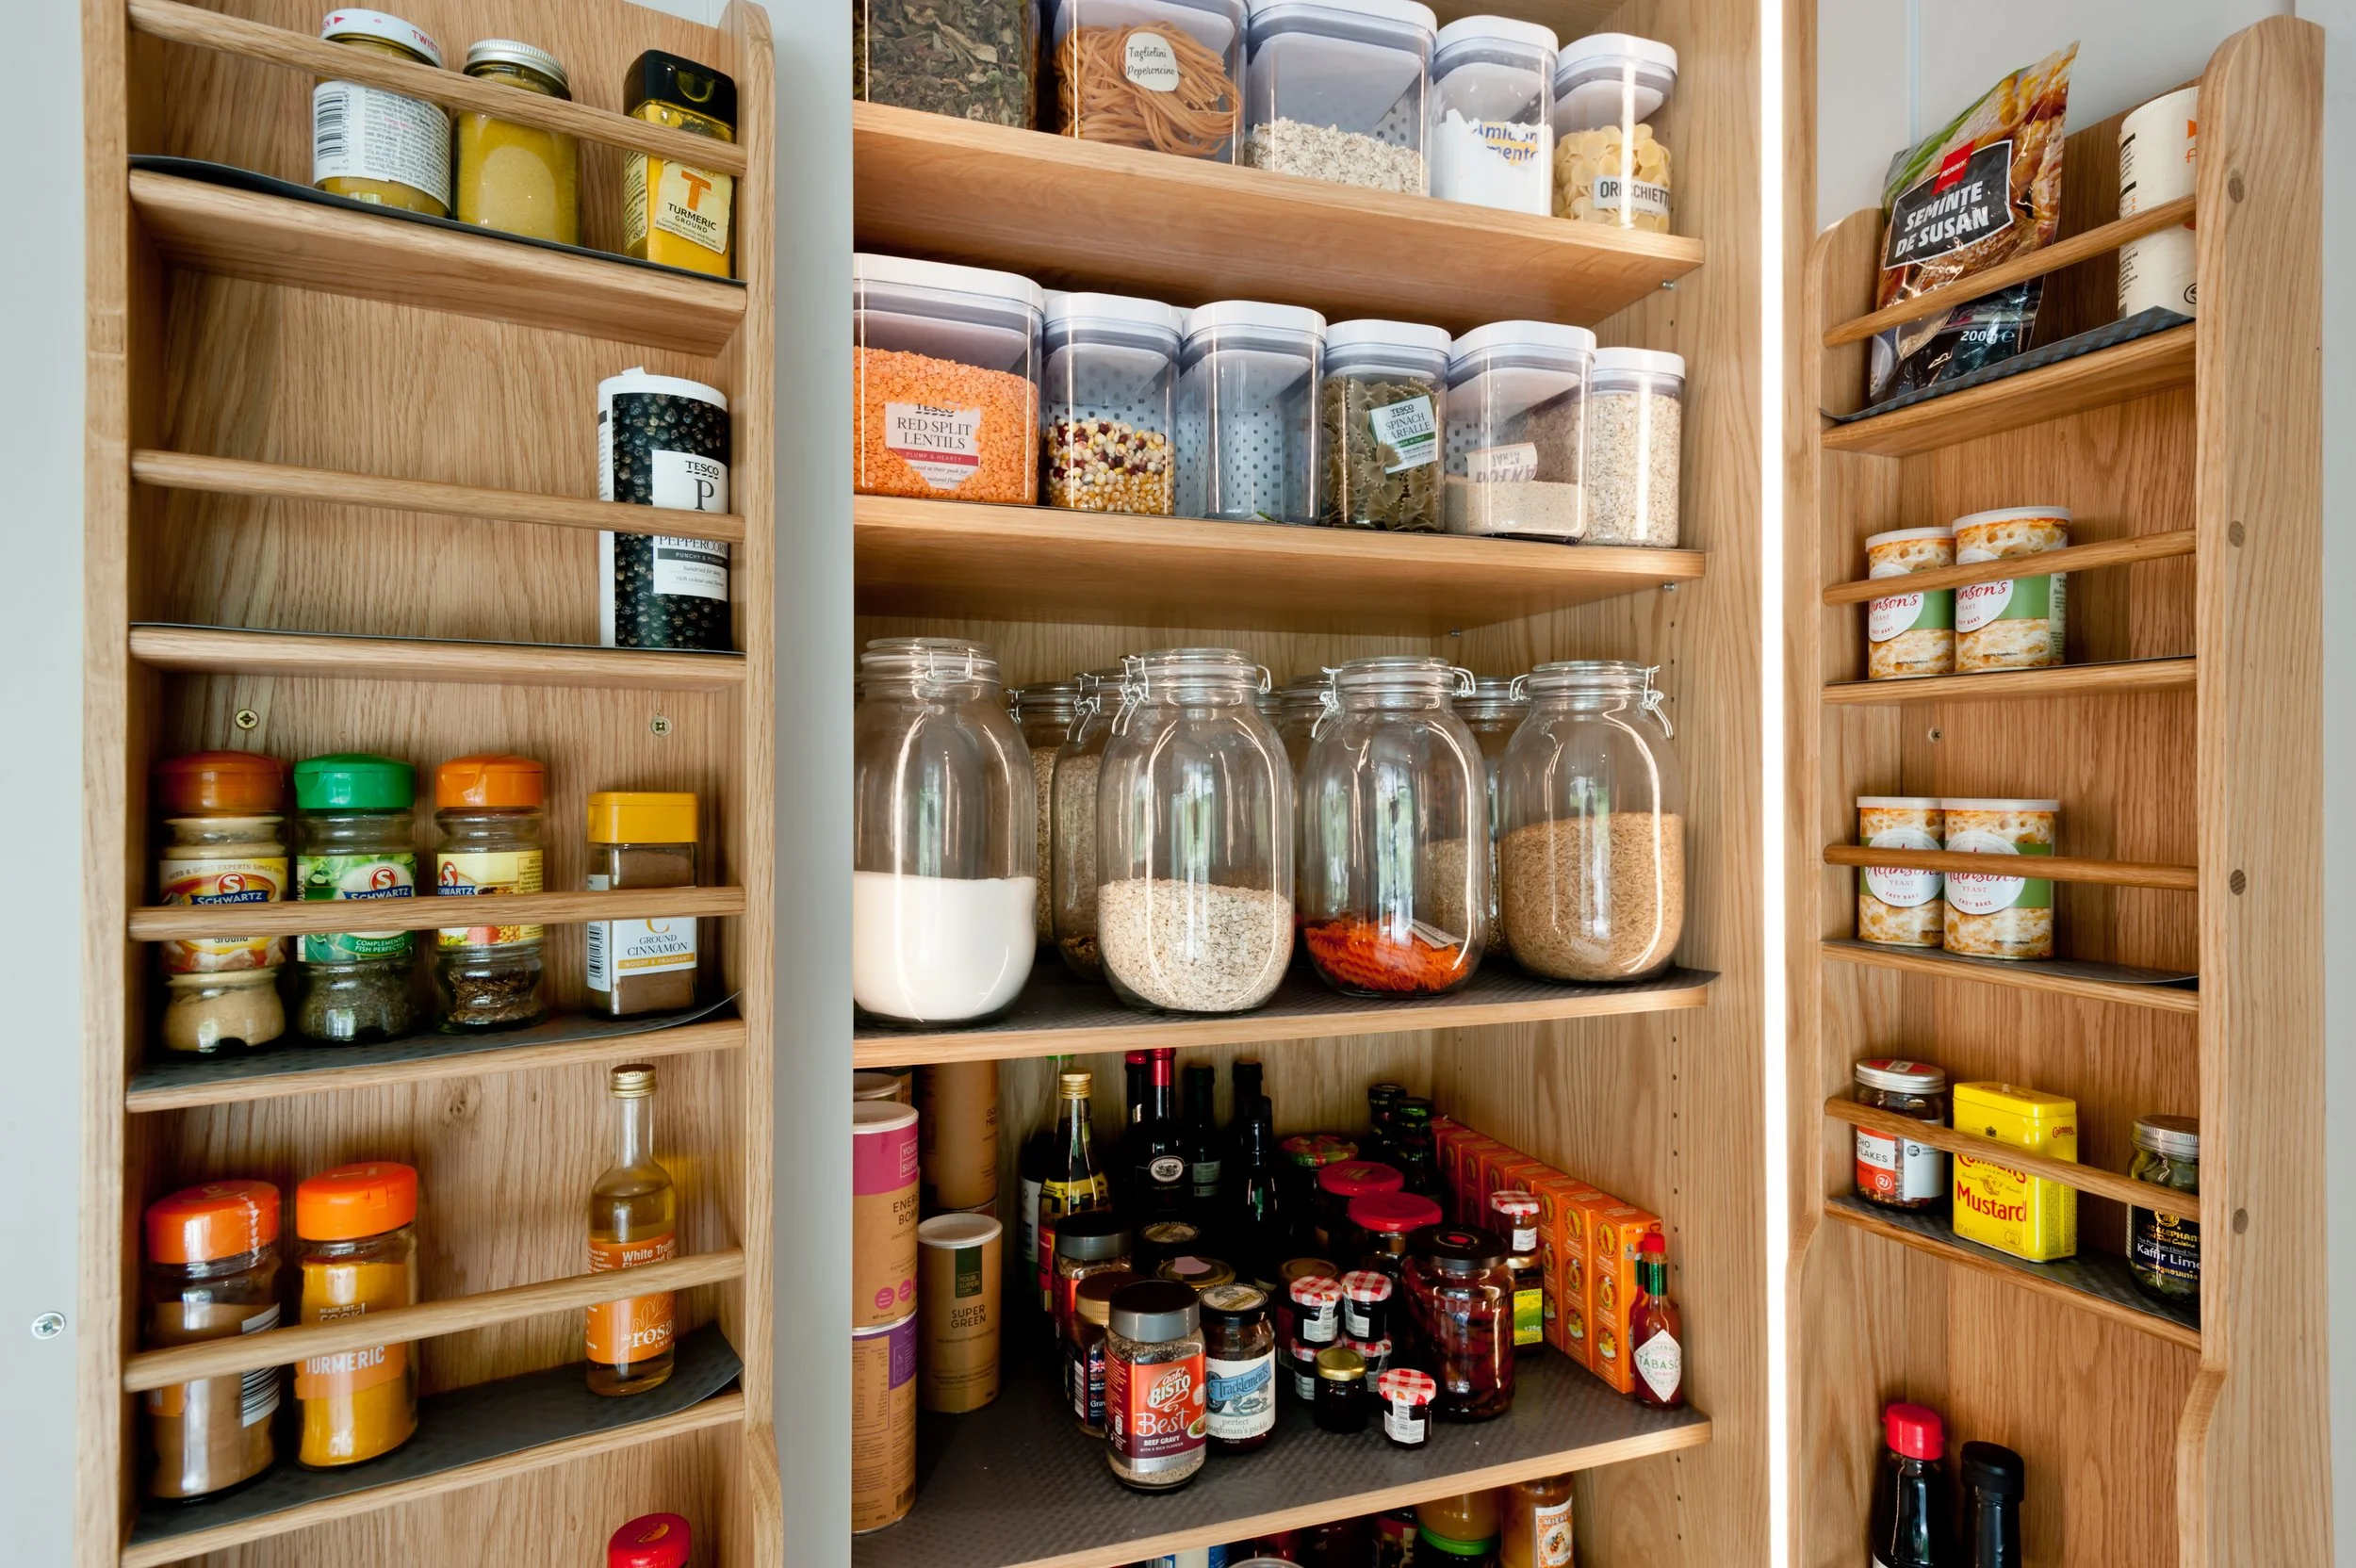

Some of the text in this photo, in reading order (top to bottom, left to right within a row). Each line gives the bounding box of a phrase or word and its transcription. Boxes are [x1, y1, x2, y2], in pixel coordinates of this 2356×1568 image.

[411, 29, 438, 53] TWIST
[1128, 46, 1168, 62] Tagliolini
[1127, 64, 1175, 80] Peperoncino
[680, 170, 712, 212] T
[1600, 181, 1672, 209] ORCHIETT
[667, 202, 717, 231] TURMERIC
[675, 215, 708, 234] GROUND
[1894, 233, 1918, 259] DE
[1390, 404, 1415, 415] TESCO
[897, 416, 972, 436] RED SPLIT
[1385, 412, 1426, 431] SPINACH
[1384, 421, 1432, 440] ARFALLE
[904, 432, 965, 449] LENTILS
[684, 460, 719, 476] TESCO
[694, 478, 714, 511] P
[675, 551, 701, 561] PUNCHY
[253, 863, 271, 872] SINCE
[196, 891, 263, 905] SCHWARTZ
[351, 888, 409, 900] SCHWARTZ
[1885, 890, 1901, 900] EASY
[1958, 898, 1972, 906] EASY
[355, 936, 404, 947] COMPLEMENTS
[372, 941, 405, 953] PERFECTLY
[639, 934, 678, 945] GROUND
[627, 941, 688, 956] CINNAMON
[624, 959, 648, 968] WOODY
[658, 955, 693, 965] FRAGRANT
[2052, 1125, 2074, 1138] Colman's
[1956, 1180, 2027, 1222] Mustard
[898, 1206, 918, 1226] BOM
[2171, 1238, 2196, 1249] Cuisine
[622, 1248, 653, 1263] White
[2137, 1243, 2167, 1261] Kaffir
[2169, 1254, 2201, 1269] Lime
[951, 1304, 986, 1319] SUPER
[950, 1314, 987, 1329] GREEN
[631, 1319, 674, 1348] rosa
[306, 1345, 385, 1375] TURMERIC
[1638, 1353, 1680, 1370] TABASC
[1215, 1366, 1269, 1397] Tracklements
[1150, 1375, 1191, 1407] BISTO
[1136, 1407, 1191, 1437] Best
[1206, 1420, 1268, 1436] oughman's pickle
[1221, 1415, 1250, 1427] perfect
[1143, 1435, 1181, 1446] BEEF GRAVY
[1166, 1442, 1184, 1450] FLAVOUR
